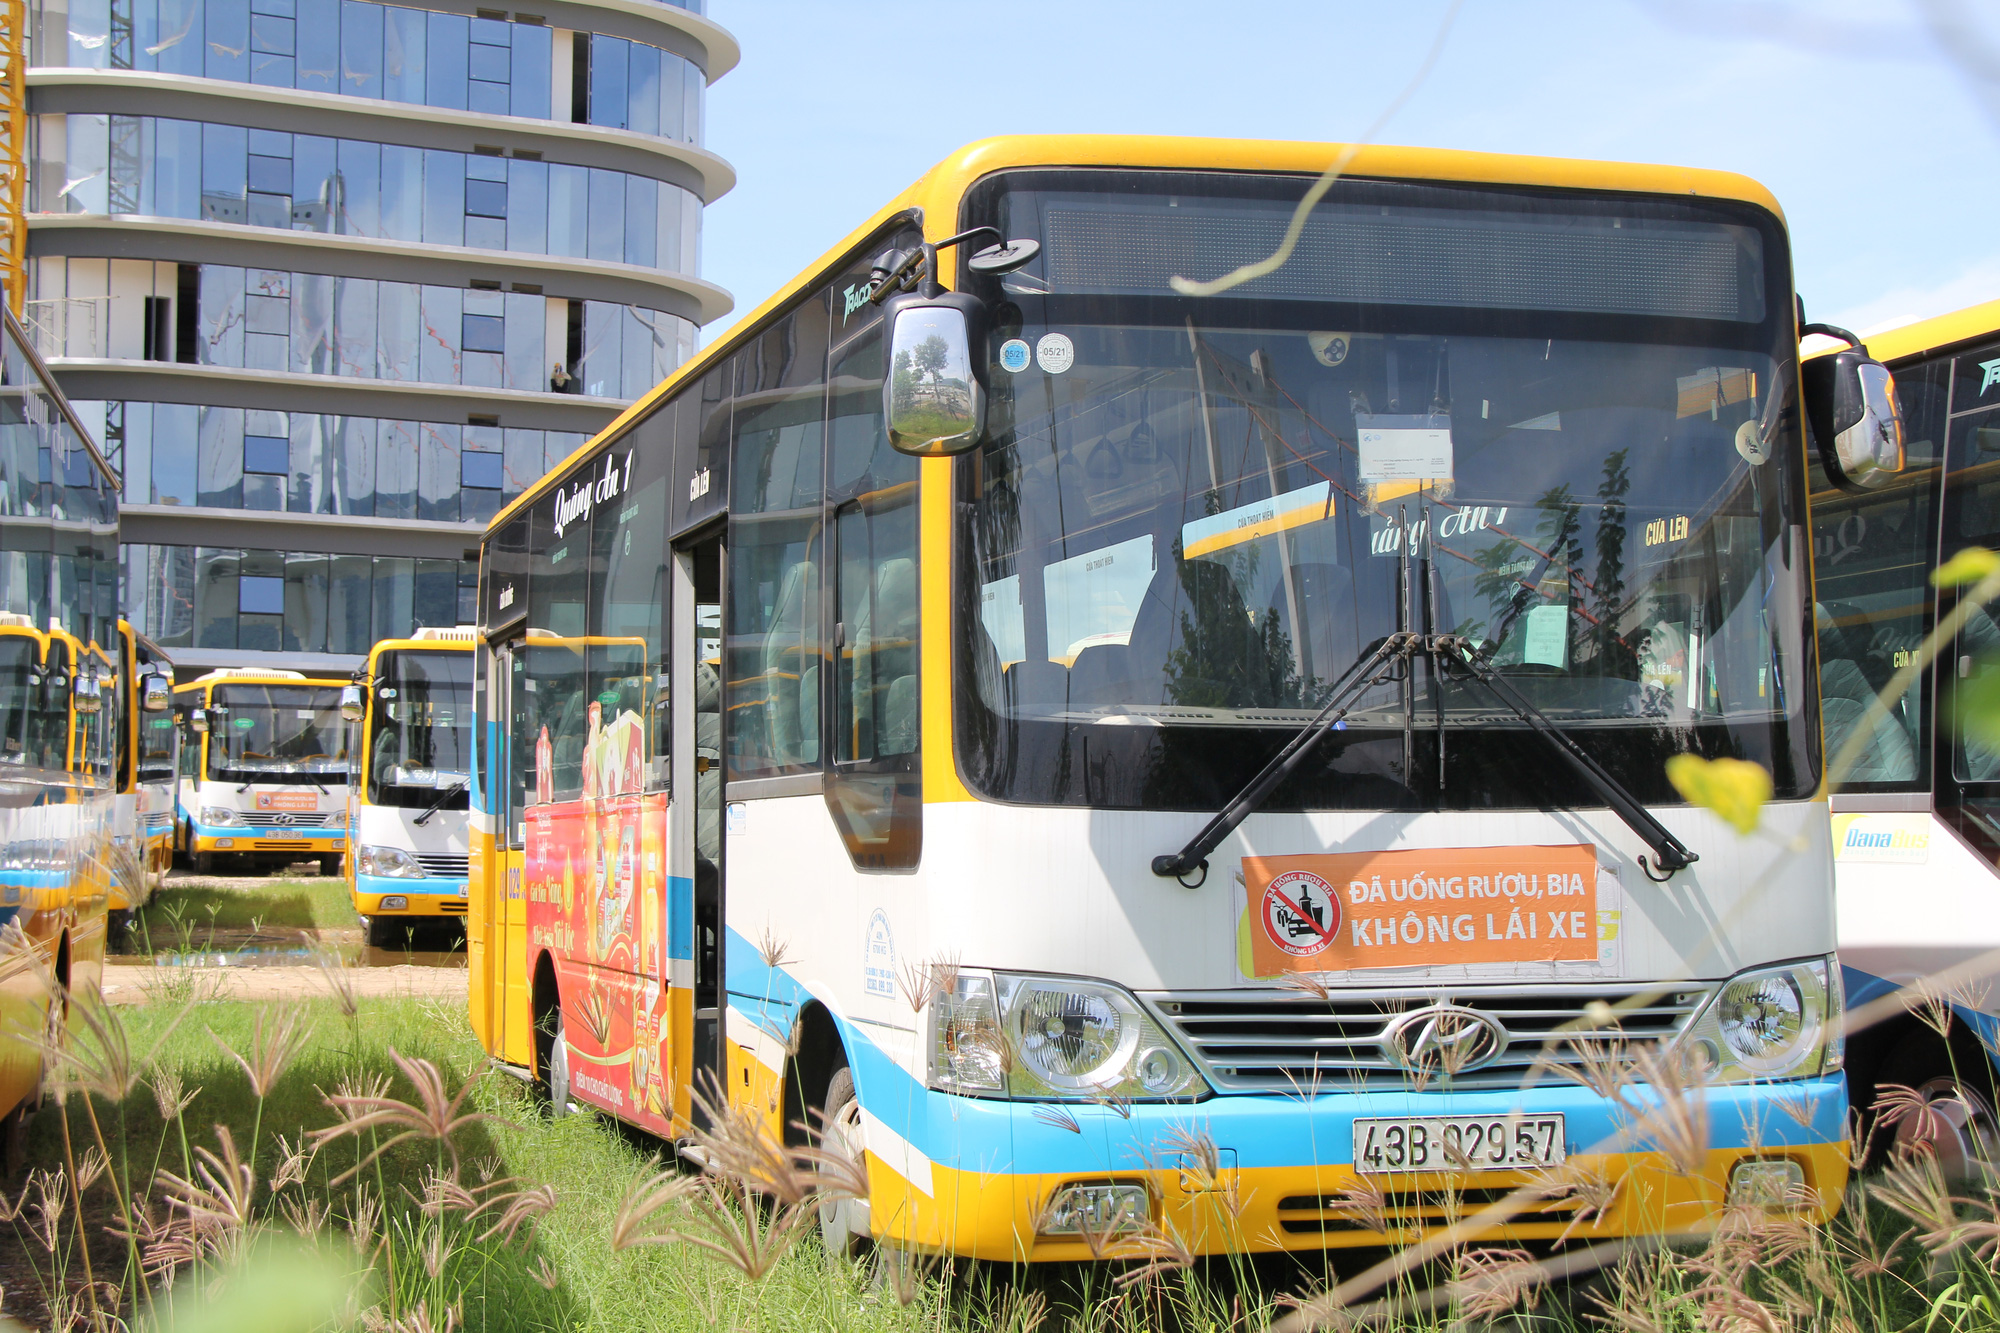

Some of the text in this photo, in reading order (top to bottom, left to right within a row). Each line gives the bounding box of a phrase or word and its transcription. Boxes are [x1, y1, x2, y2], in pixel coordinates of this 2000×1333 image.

[842, 283, 873, 329] TRACO
[1004, 349, 1024, 358] 05/21
[1043, 347, 1065, 356] 05/21
[554, 481, 593, 539] Quảng
[595, 453, 619, 504] An
[623, 448, 633, 492] 1
[1669, 513, 1690, 542] LÊN
[1845, 828, 1930, 849] DanaBus
[1349, 870, 1586, 904] ĐÃ UỐNG RƯỢU, BIA
[1351, 910, 1476, 947] KHÔNG
[1486, 906, 1537, 940] LÁI
[1547, 911, 1587, 938] XE
[1362, 1119, 1558, 1168] 43B-029.57
